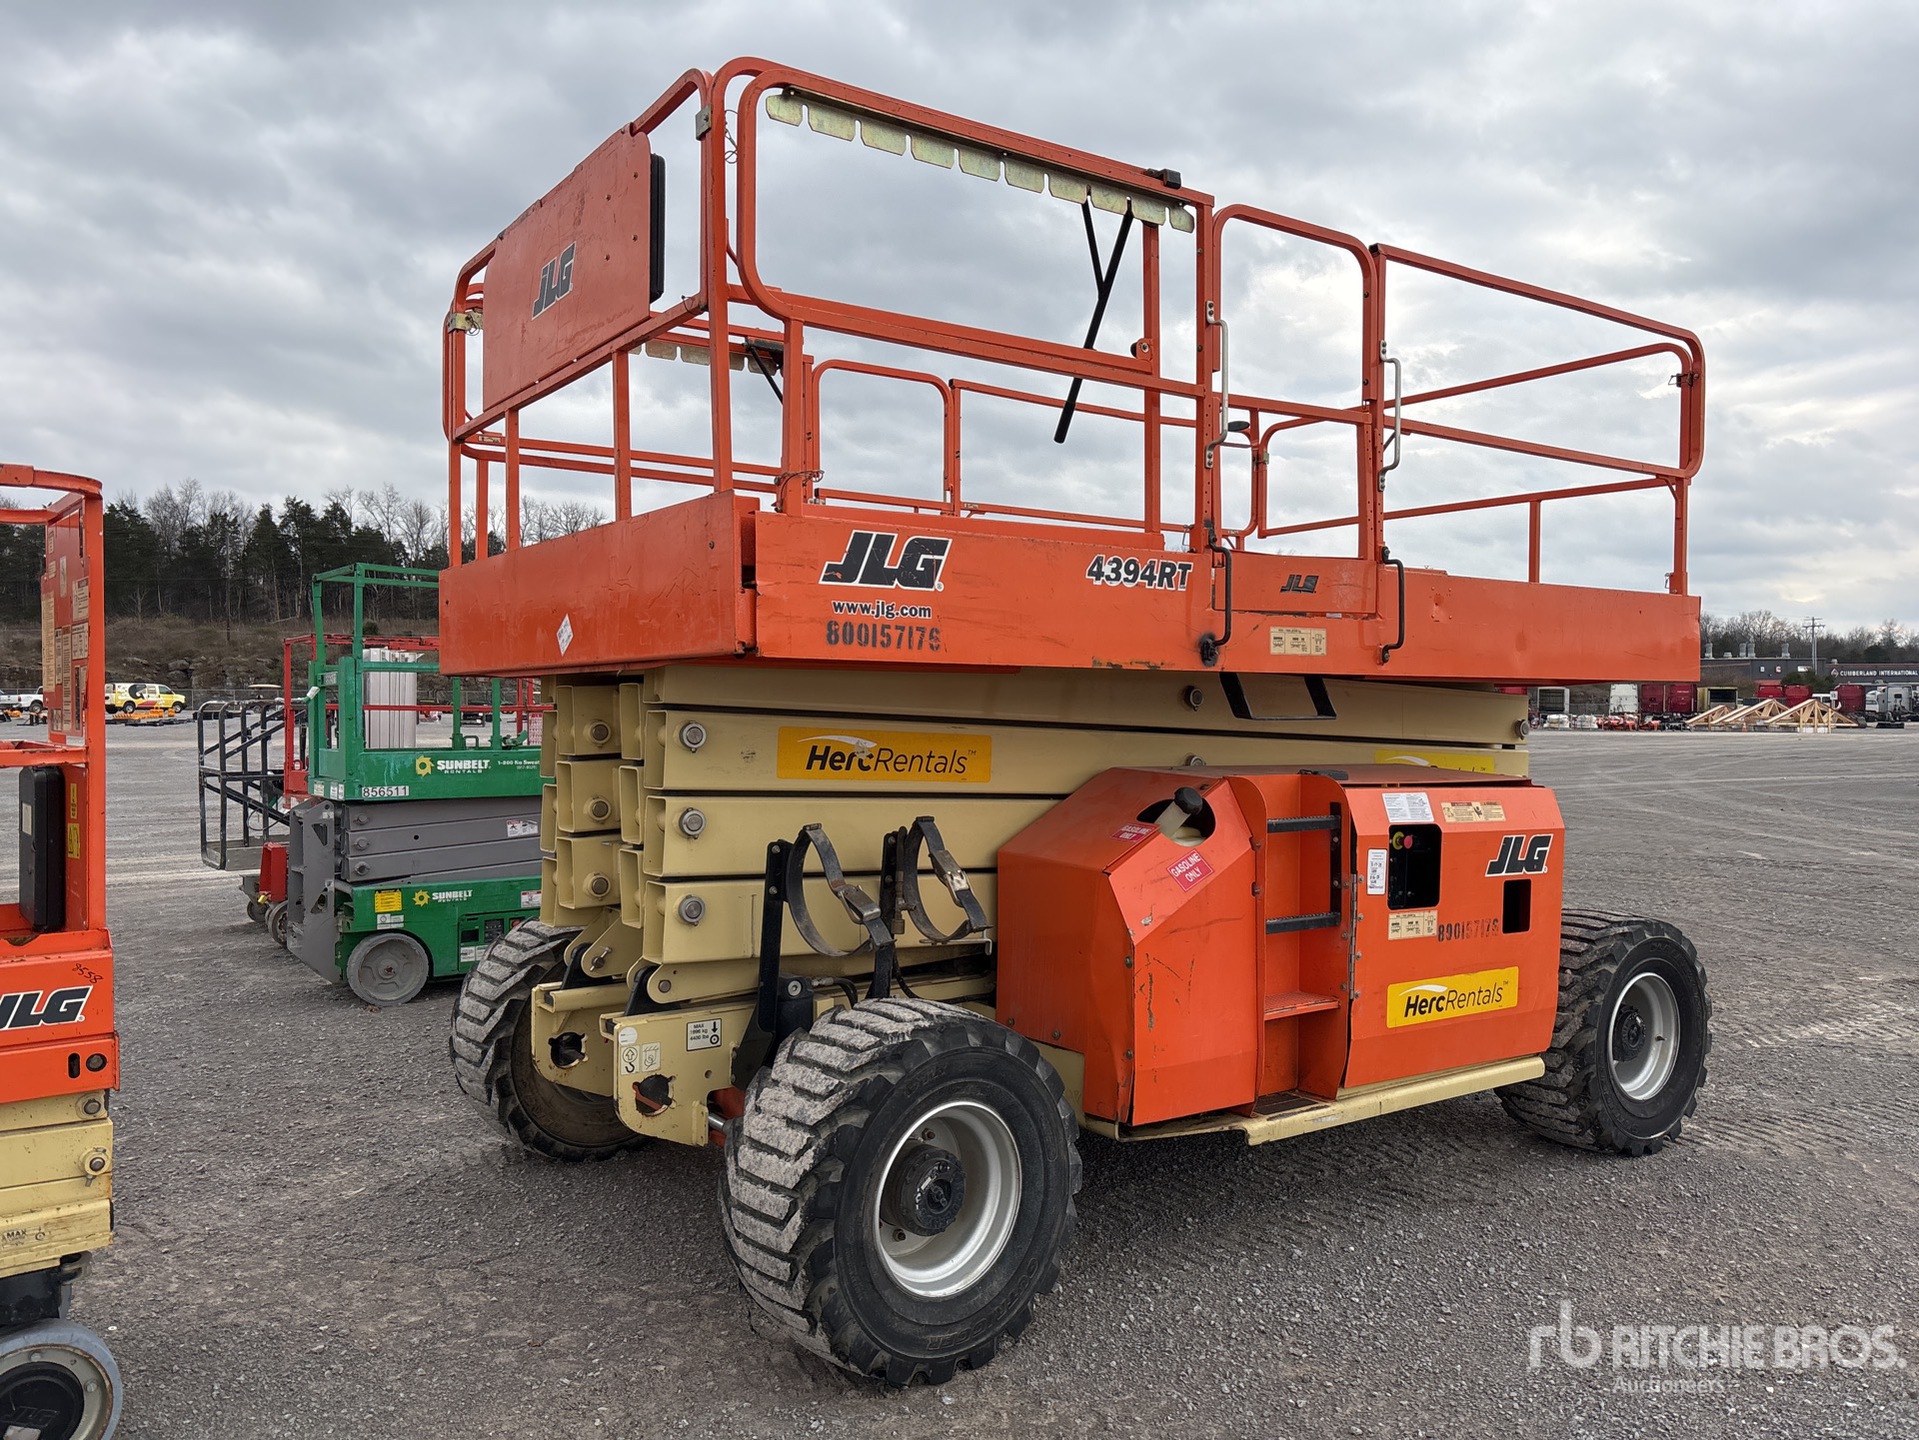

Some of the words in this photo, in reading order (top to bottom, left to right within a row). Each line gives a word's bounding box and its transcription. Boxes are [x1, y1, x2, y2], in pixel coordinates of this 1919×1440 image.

[532, 241, 577, 320] JLG
[818, 529, 953, 591] JLG
[1085, 554, 1194, 591] 4394RT
[1280, 574, 1319, 594] JLG
[832, 600, 932, 619] www.jlg.com
[436, 759, 491, 770] SUNBELT
[805, 745, 969, 775] HercRentals
[362, 786, 408, 797] 856511
[1170, 853, 1202, 878] GASOLINE
[1485, 834, 1554, 877] JLG
[1184, 867, 1203, 882] ONLY
[432, 889, 473, 900] SUNBELT
[1403, 981, 1504, 1018] HercRentals
[7, 1228, 28, 1239] MAX
